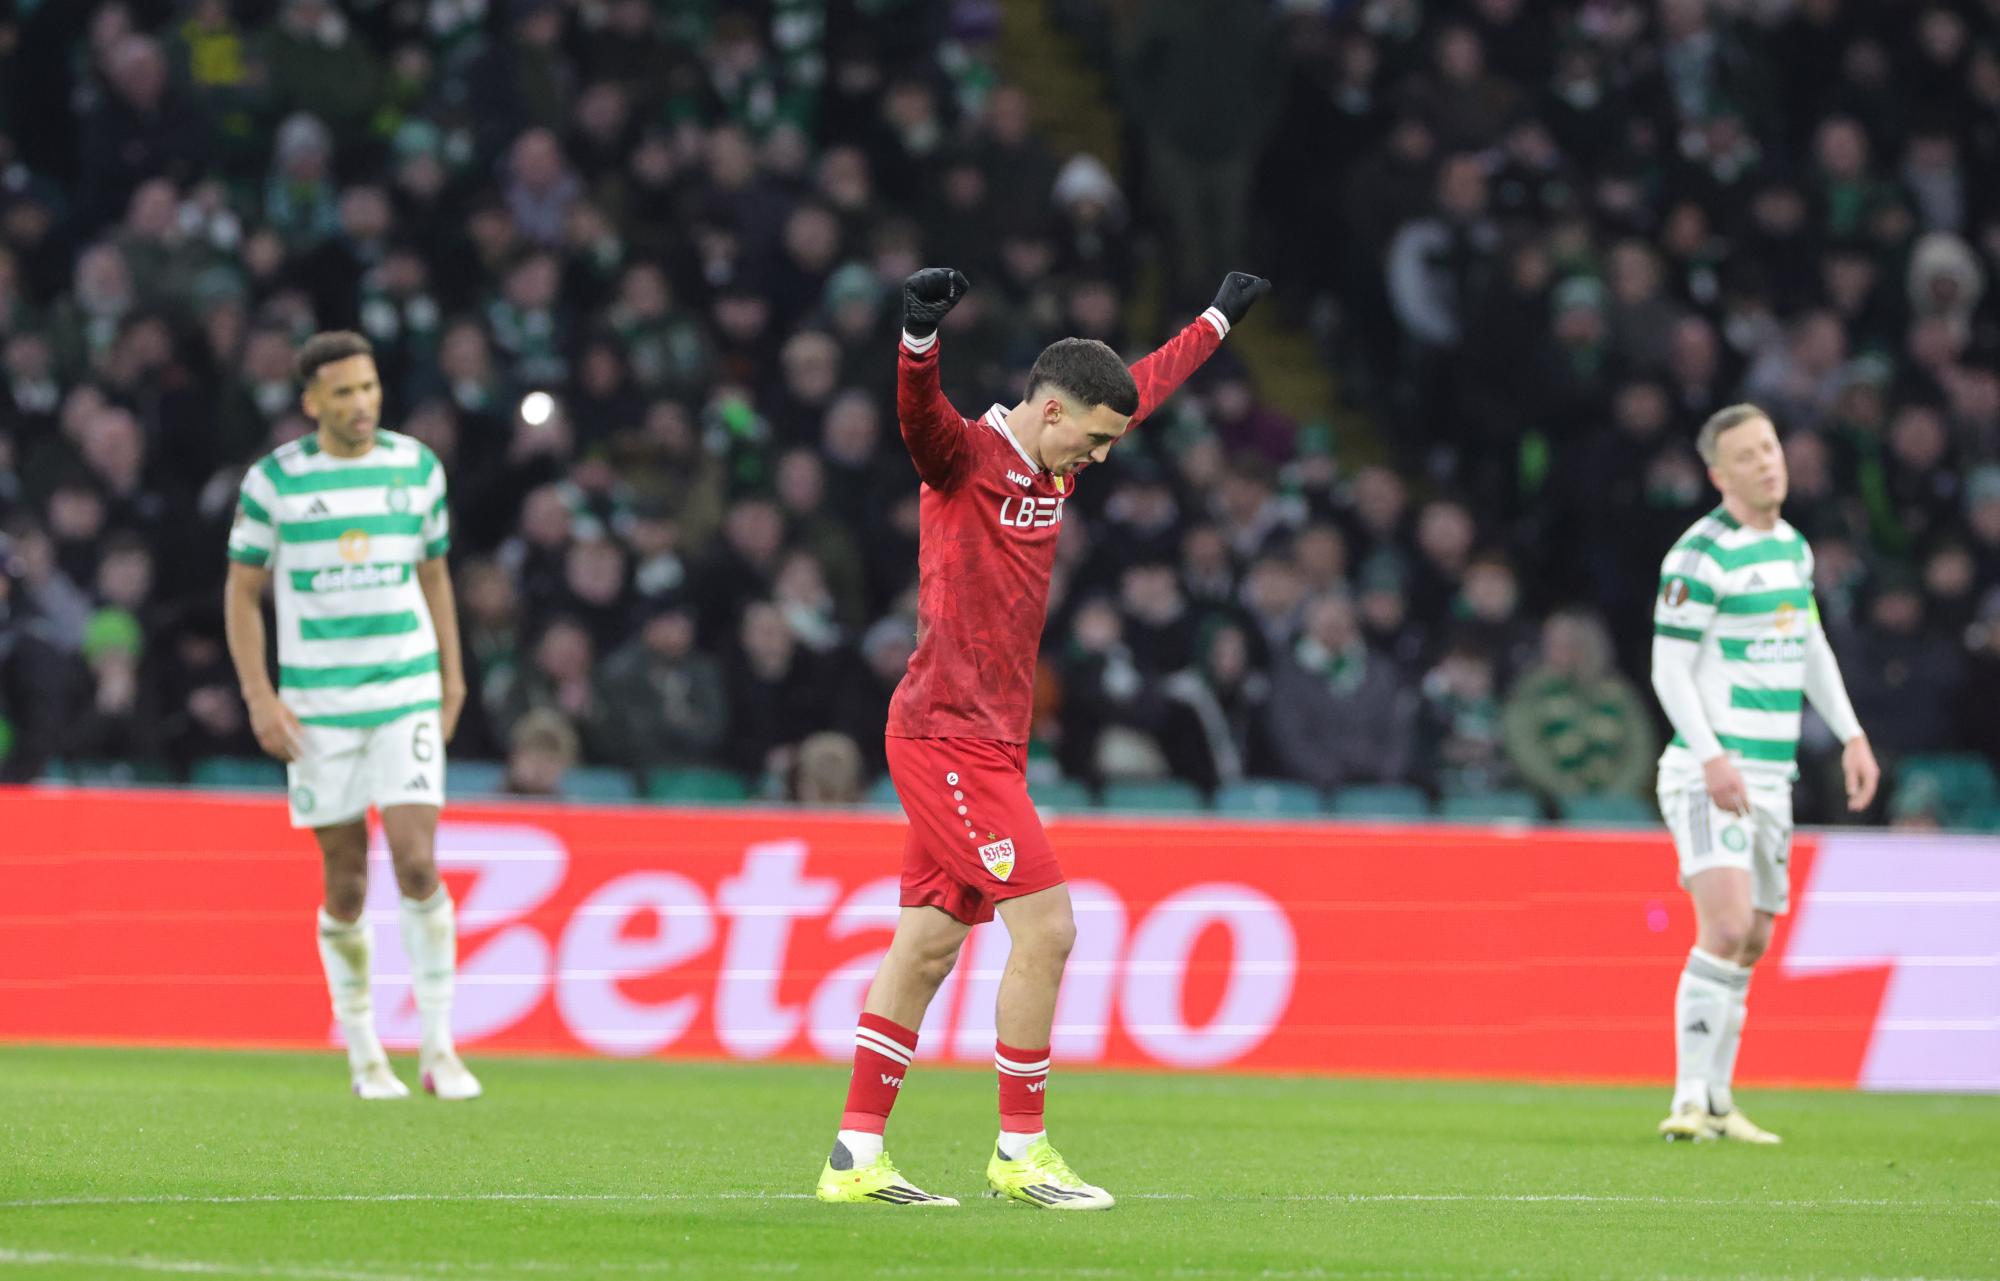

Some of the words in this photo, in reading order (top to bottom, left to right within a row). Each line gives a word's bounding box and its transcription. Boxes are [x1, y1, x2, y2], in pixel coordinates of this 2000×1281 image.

[1006, 468, 1032, 487] JAKO
[412, 721, 434, 763] 6
[329, 818, 1298, 1070] Betano
